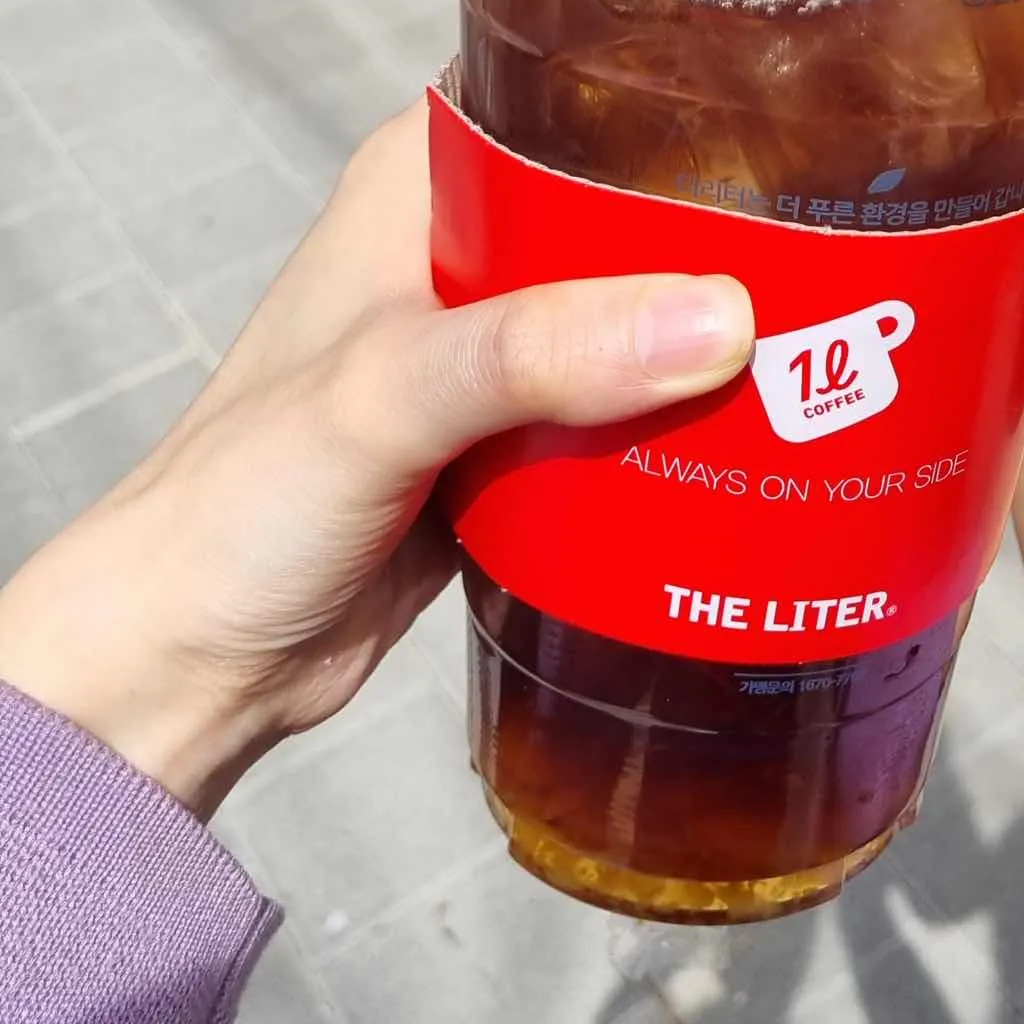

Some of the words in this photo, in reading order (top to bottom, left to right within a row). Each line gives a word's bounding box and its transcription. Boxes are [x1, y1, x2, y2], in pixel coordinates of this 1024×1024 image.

[777, 193, 801, 220] 더
[806, 197, 856, 225] 푸른
[860, 200, 930, 226] 환경을
[934, 190, 992, 222] 만들어
[803, 388, 866, 419] COFFEE
[620, 445, 748, 496] ALWAYS
[760, 475, 810, 502] ON
[824, 471, 906, 502] YOUR
[914, 449, 970, 490] SIDE
[663, 583, 751, 630] THE
